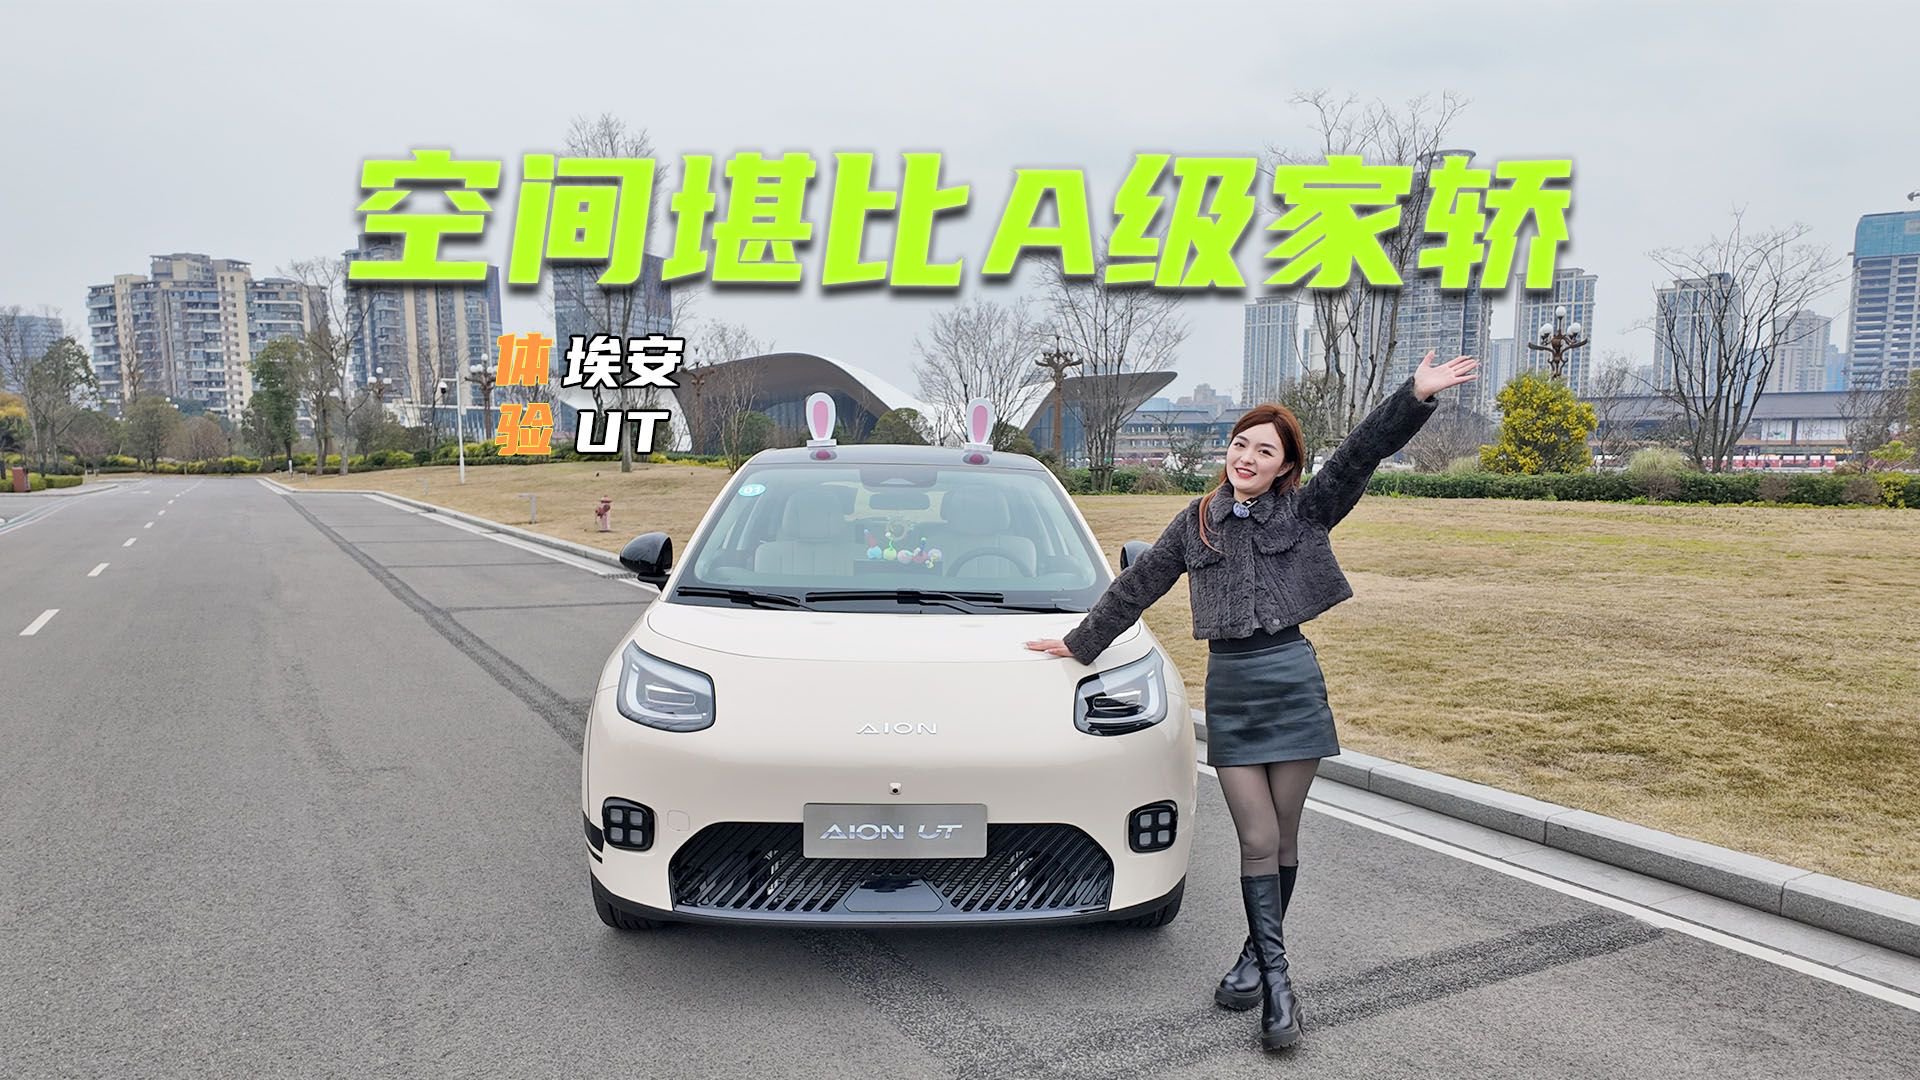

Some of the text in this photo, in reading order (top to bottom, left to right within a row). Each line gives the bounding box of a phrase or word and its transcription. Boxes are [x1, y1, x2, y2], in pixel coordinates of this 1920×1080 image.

[856, 721, 938, 735] AION
[820, 823, 963, 840] AION UT
